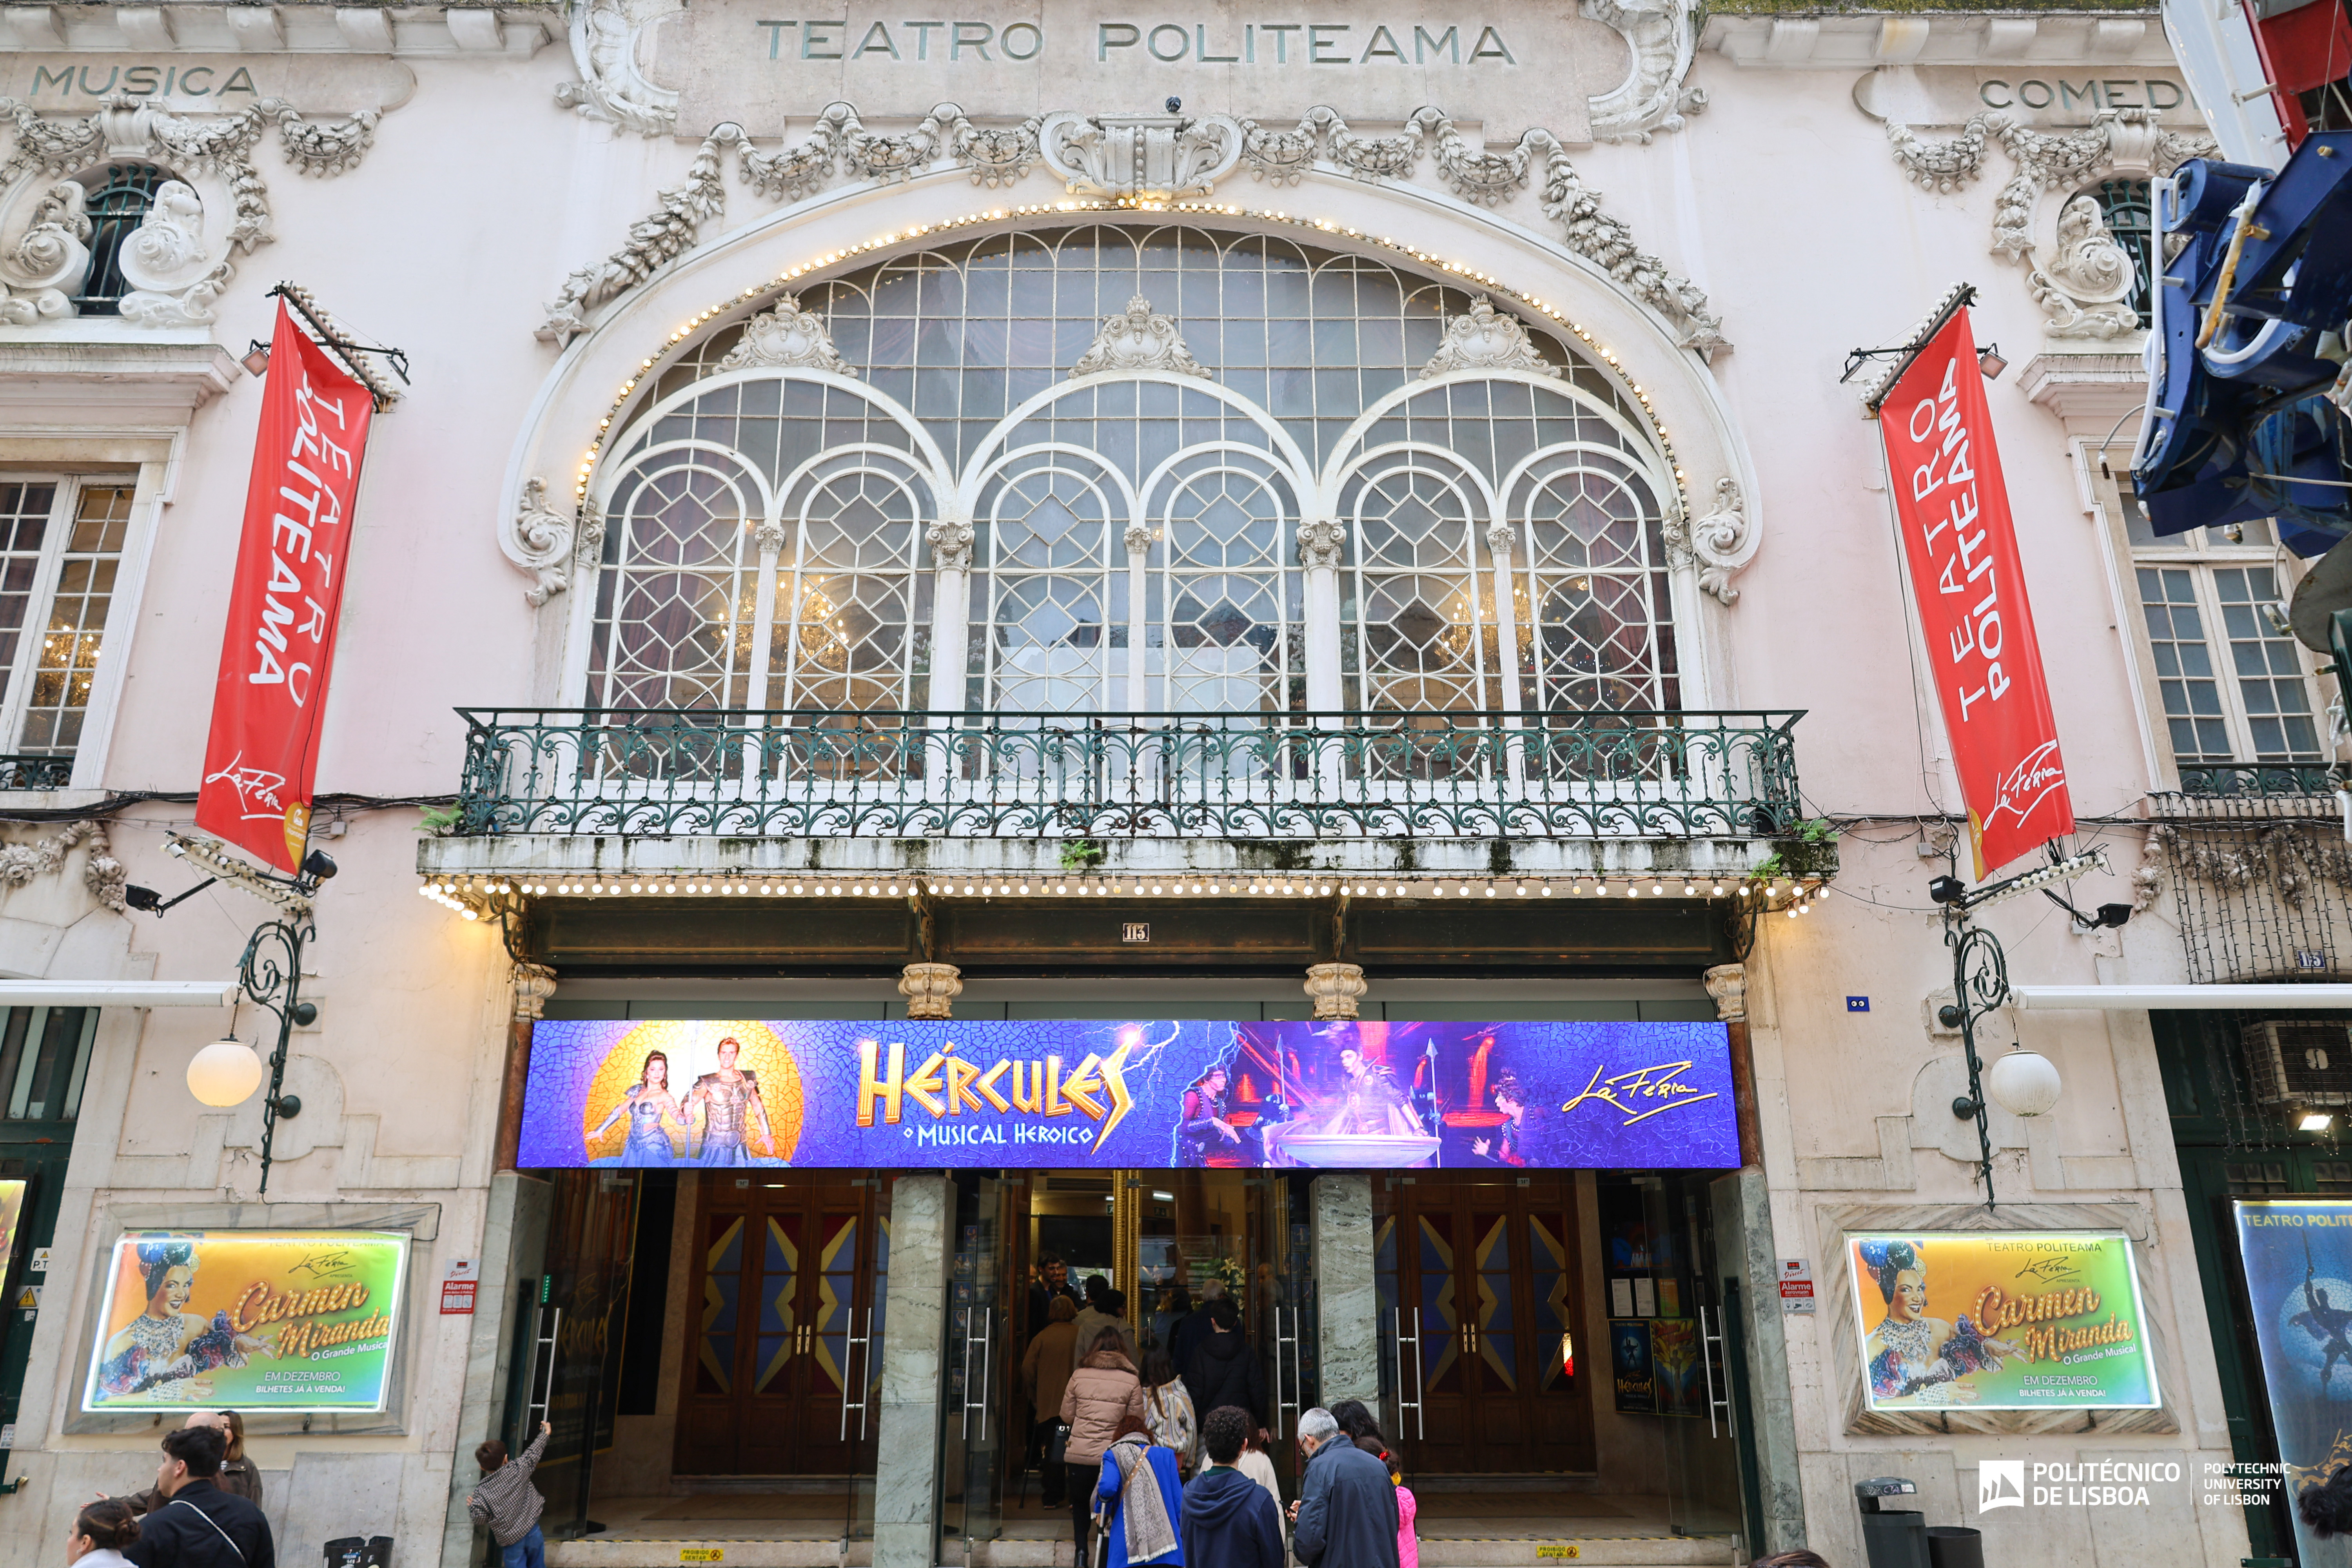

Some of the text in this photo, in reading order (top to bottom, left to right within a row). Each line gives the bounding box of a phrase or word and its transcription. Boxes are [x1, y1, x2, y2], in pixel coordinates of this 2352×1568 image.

[756, 20, 1516, 65] TEATRO POLITEAMA
[30, 65, 258, 96] MUSICA
[1938, 358, 2010, 701] POLITEAMA
[289, 393, 352, 708] TEATRO
[1910, 398, 1986, 722] TEATRO
[1125, 925, 1145, 940] 113
[856, 1032, 1135, 1155] HÉRCULES
[918, 1124, 1007, 1147] MUSICAL
[1014, 1123, 1094, 1143] HEROICO
[2243, 1215, 2303, 1227] TEATRO
[1987, 1243, 2102, 1252] TEATRO POLITEAMA
[1784, 1269, 1805, 1278] Direct
[232, 1280, 369, 1332] Carmen
[1973, 1285, 2100, 1337] Carmen
[277, 1306, 390, 1360] Miranda
[2025, 1311, 2133, 1363] Miranda
[312, 1352, 320, 1361] O
[322, 1346, 355, 1359] Grande
[2063, 1343, 2136, 1365] O Grande Musical
[265, 1372, 341, 1381] EM DEZEMBRO
[294, 1384, 304, 1393] JÁ
[306, 1384, 312, 1393] À
[2023, 1376, 2098, 1385] EM DEZEMBRO
[2057, 1388, 2067, 1397] JÁ
[2069, 1388, 2074, 1396] À
